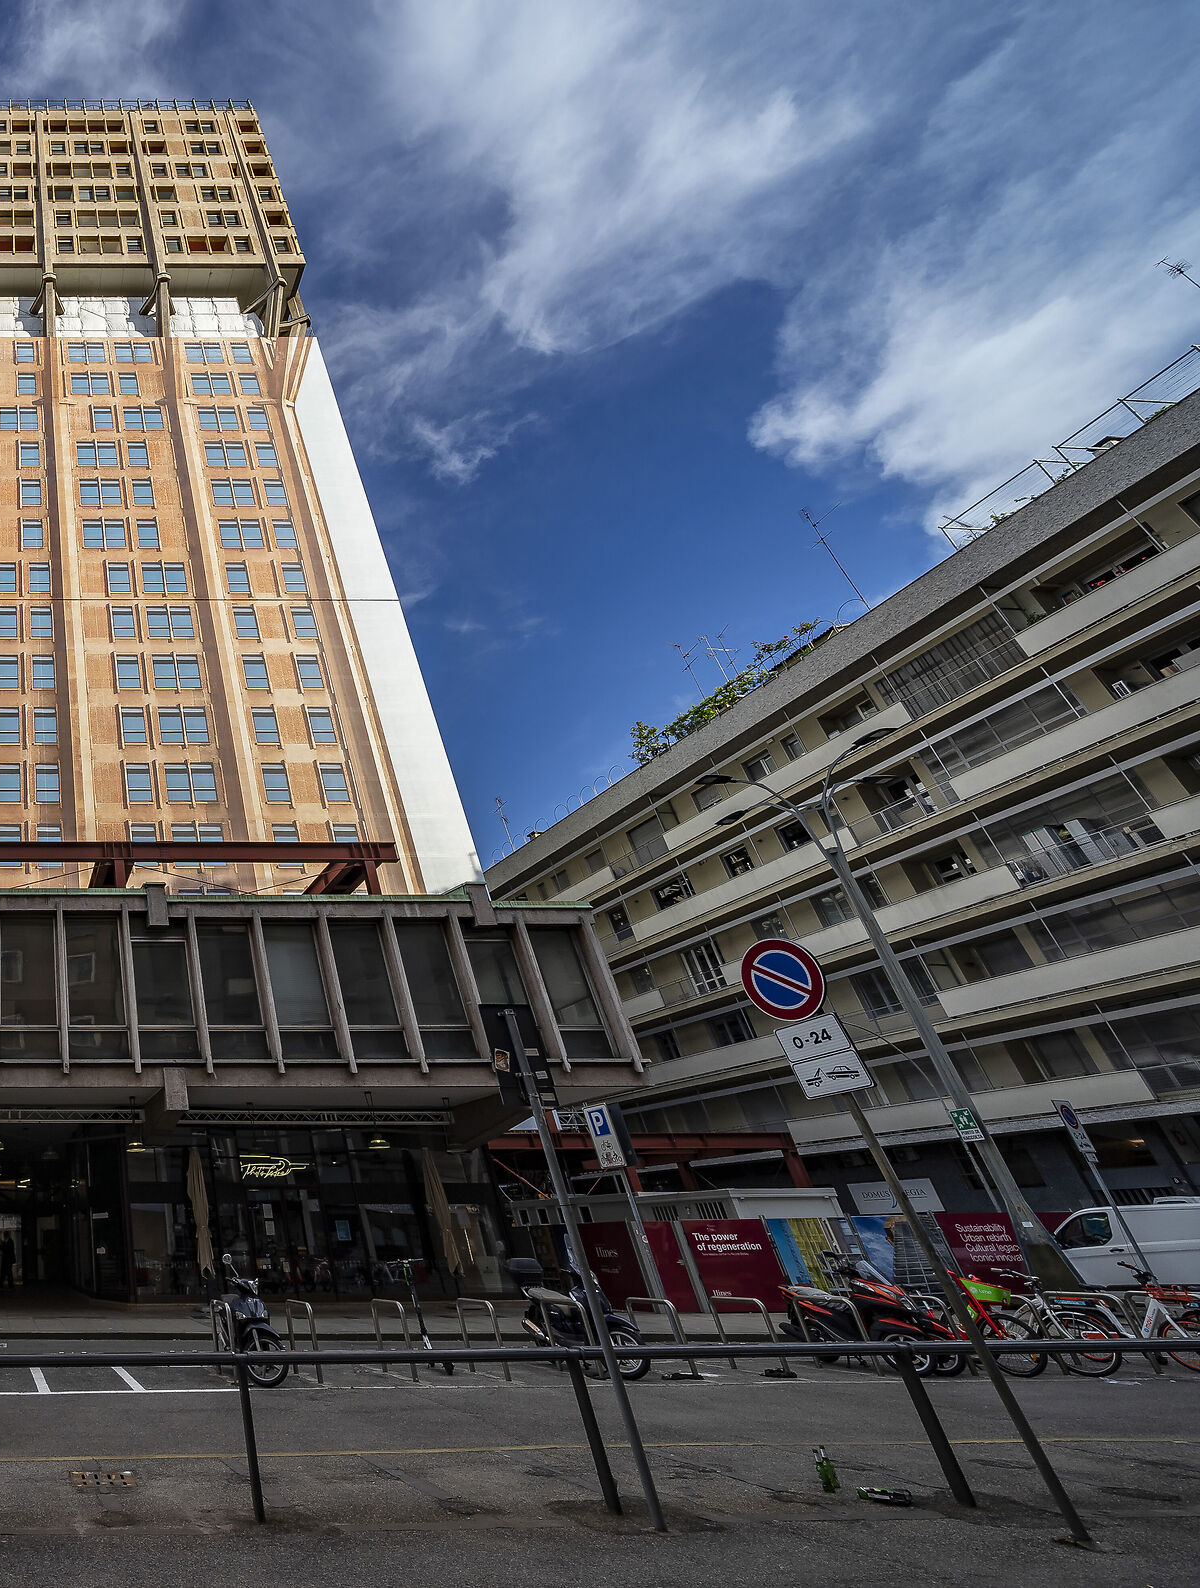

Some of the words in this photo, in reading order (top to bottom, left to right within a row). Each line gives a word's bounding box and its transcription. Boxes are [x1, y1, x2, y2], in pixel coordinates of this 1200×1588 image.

[792, 1028, 832, 1049] 0-24
[592, 1113, 604, 1135] P
[861, 1190, 891, 1199] DOMUS
[904, 1188, 927, 1197] EGIA
[954, 1223, 1006, 1234] Sustainability
[691, 1232, 710, 1241] The
[711, 1233, 738, 1243] power
[959, 1233, 986, 1242] Urban
[986, 1232, 1013, 1242] rebirth
[696, 1242, 706, 1251] of
[707, 1241, 763, 1253] regeneration
[965, 1243, 996, 1252] Cultural
[969, 1253, 995, 1262] Iconic
[995, 1253, 1024, 1262] innovat
